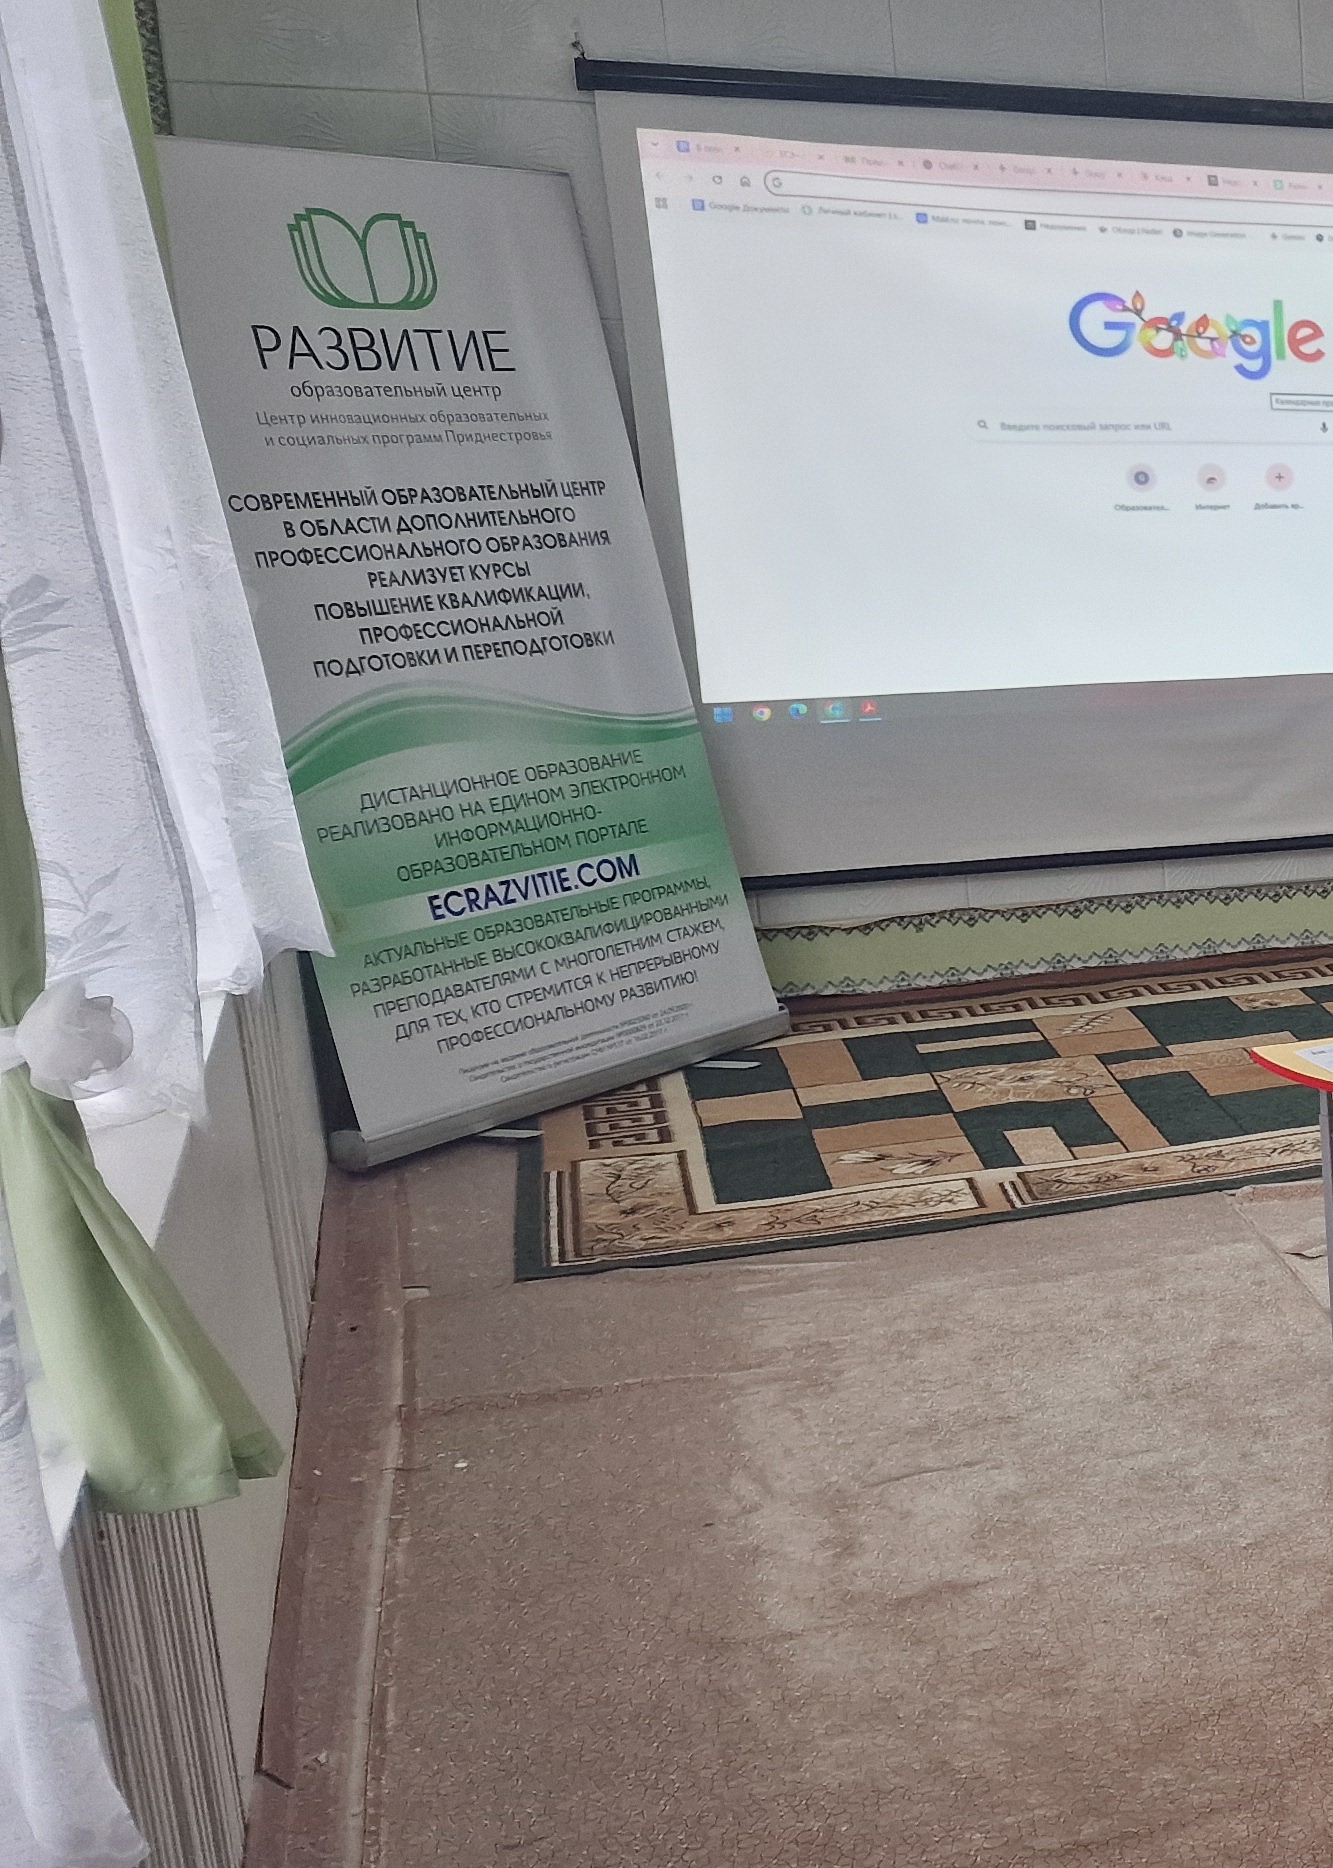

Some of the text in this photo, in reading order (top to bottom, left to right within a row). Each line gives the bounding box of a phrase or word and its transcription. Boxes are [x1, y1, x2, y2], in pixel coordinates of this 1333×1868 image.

[251, 324, 516, 372] РАЗВИТИЕ
[1068, 291, 1327, 380] Google
[290, 381, 502, 402] образовательный центр
[255, 409, 549, 428] Центр инновационных образовательных
[264, 429, 552, 448] и социальных программ Приднестровья
[1000, 420, 1172, 433] Введите поисковый запрос или URL
[228, 479, 606, 512] СОВРЕМЕННЫЙ ОБРАЗОВАТЕЛЬНЫЙ ЦЕНТР
[283, 507, 576, 538] В ОБЛАСТИ ДОПОЛНИТЕЛЬНОГО
[254, 530, 610, 568] ПРОФЕССИОНАЛЬНОГО ОБРАЗОВАНИЯ
[367, 561, 531, 588] РЕАЛИЗУЕТ КУРСЫ
[314, 582, 590, 621] ПОВЫШЕНИЕ КВАЛИФИКАЦИИ,
[358, 606, 564, 645] ПРОФЕССИОНАЛЬНОЙ
[313, 630, 614, 678] ПОДГОТОВКИ И ПЕРЕПОДГОТОВКИ
[316, 765, 686, 843] РЕАЛИЗОВАНО НА ЕДИНОМ ЭЛЕКТРОННОМ
[360, 749, 643, 814] ДИСТАНЦИОННОЕ ОБРАЗОВАНИЕ
[397, 818, 650, 882] ОБРАЗОВАТЕЛЬНОМ ПОРТАЛЕ
[434, 805, 602, 848] ИНФОРМАЦИОННО-
[427, 854, 640, 920] ECRAZVITIE.COM
[350, 894, 729, 997] РАЗРАБОТАННЫЕ ВЫСОКОКВАЛИФИЦИРОВАННЫМИ
[364, 931, 471, 968] АКТУАЛЬНЫЕ
[473, 896, 620, 942] ОБРАЗОВАТЕЛЬНЫЕ
[373, 918, 725, 1018] ПРЕПОДАВАТЕЛЯМИ С МНОГОЛЕТНИМ СТАЖЕМ,
[395, 940, 720, 1043] ДЛЯ ТЕХ, КТО СТРЕМИТСЯ К НЕПРЕРЫВНОМУ
[436, 994, 615, 1054] ПРОФЕССИОНАЛЬНОМУ
[619, 970, 698, 1002] РАЗВИТИЮ!
